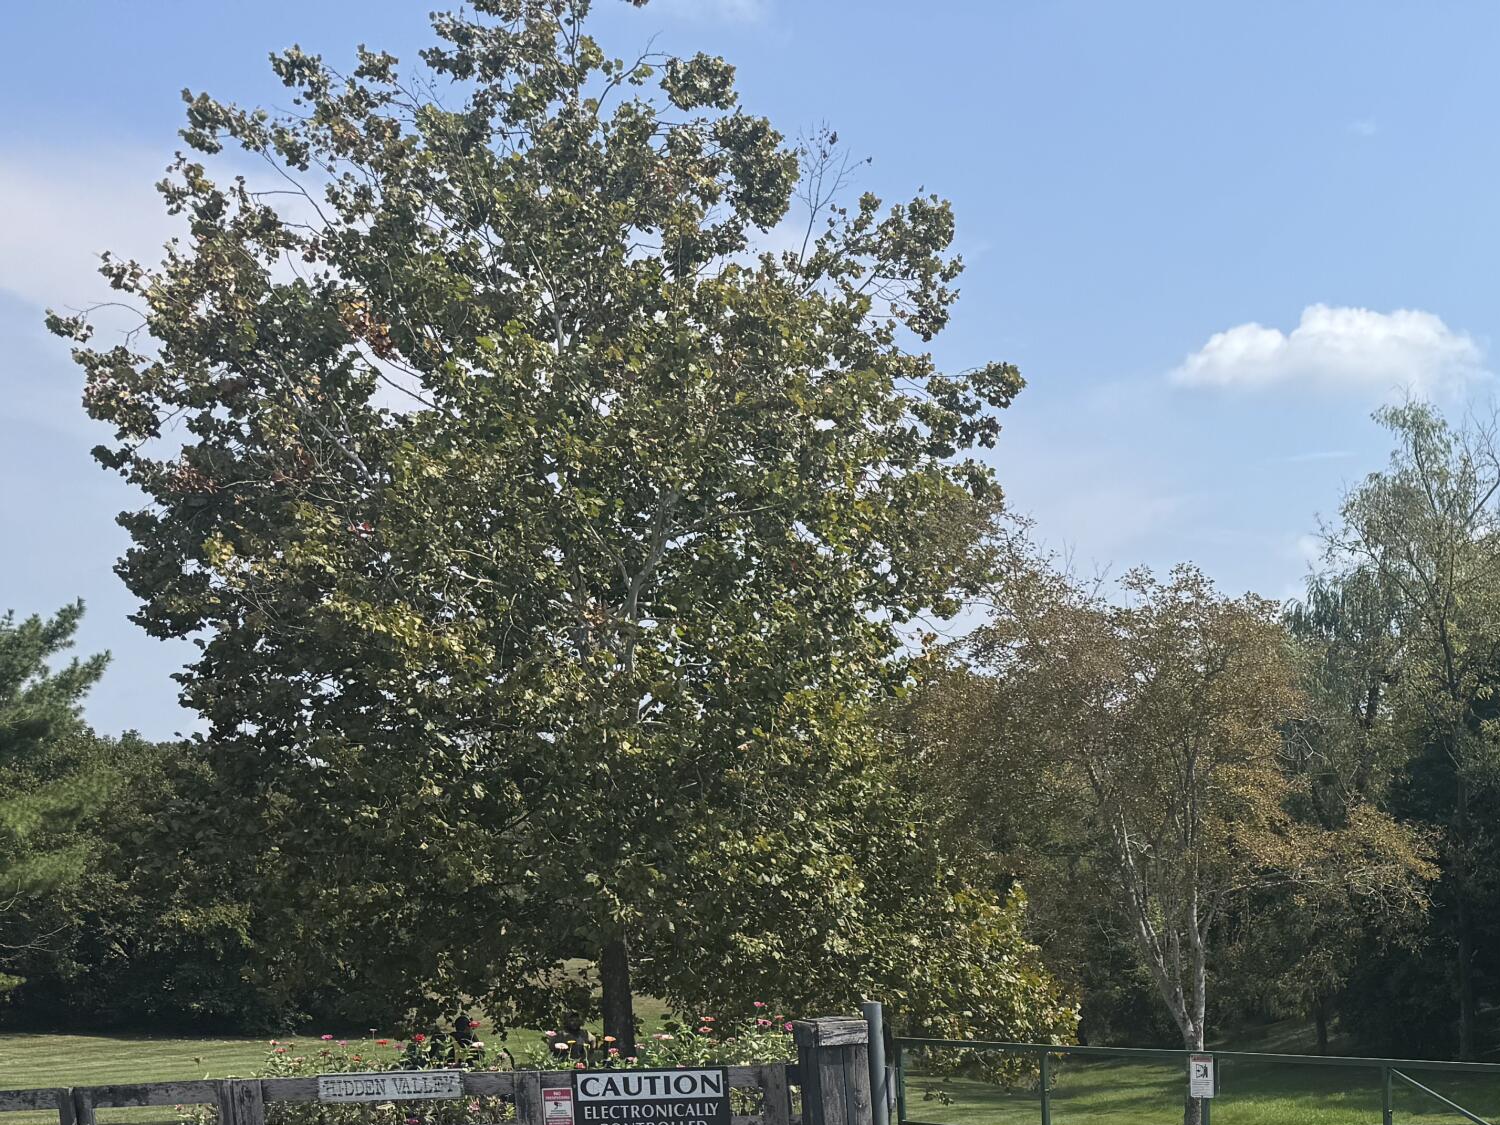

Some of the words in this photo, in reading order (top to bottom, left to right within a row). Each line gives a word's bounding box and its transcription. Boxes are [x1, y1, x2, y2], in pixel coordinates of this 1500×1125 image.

[323, 1078, 387, 1097] HIDDEN
[391, 1075, 456, 1095] VALLEY
[580, 1074, 721, 1097] CAUTION
[584, 1102, 719, 1120] ELECTRONICALLY
